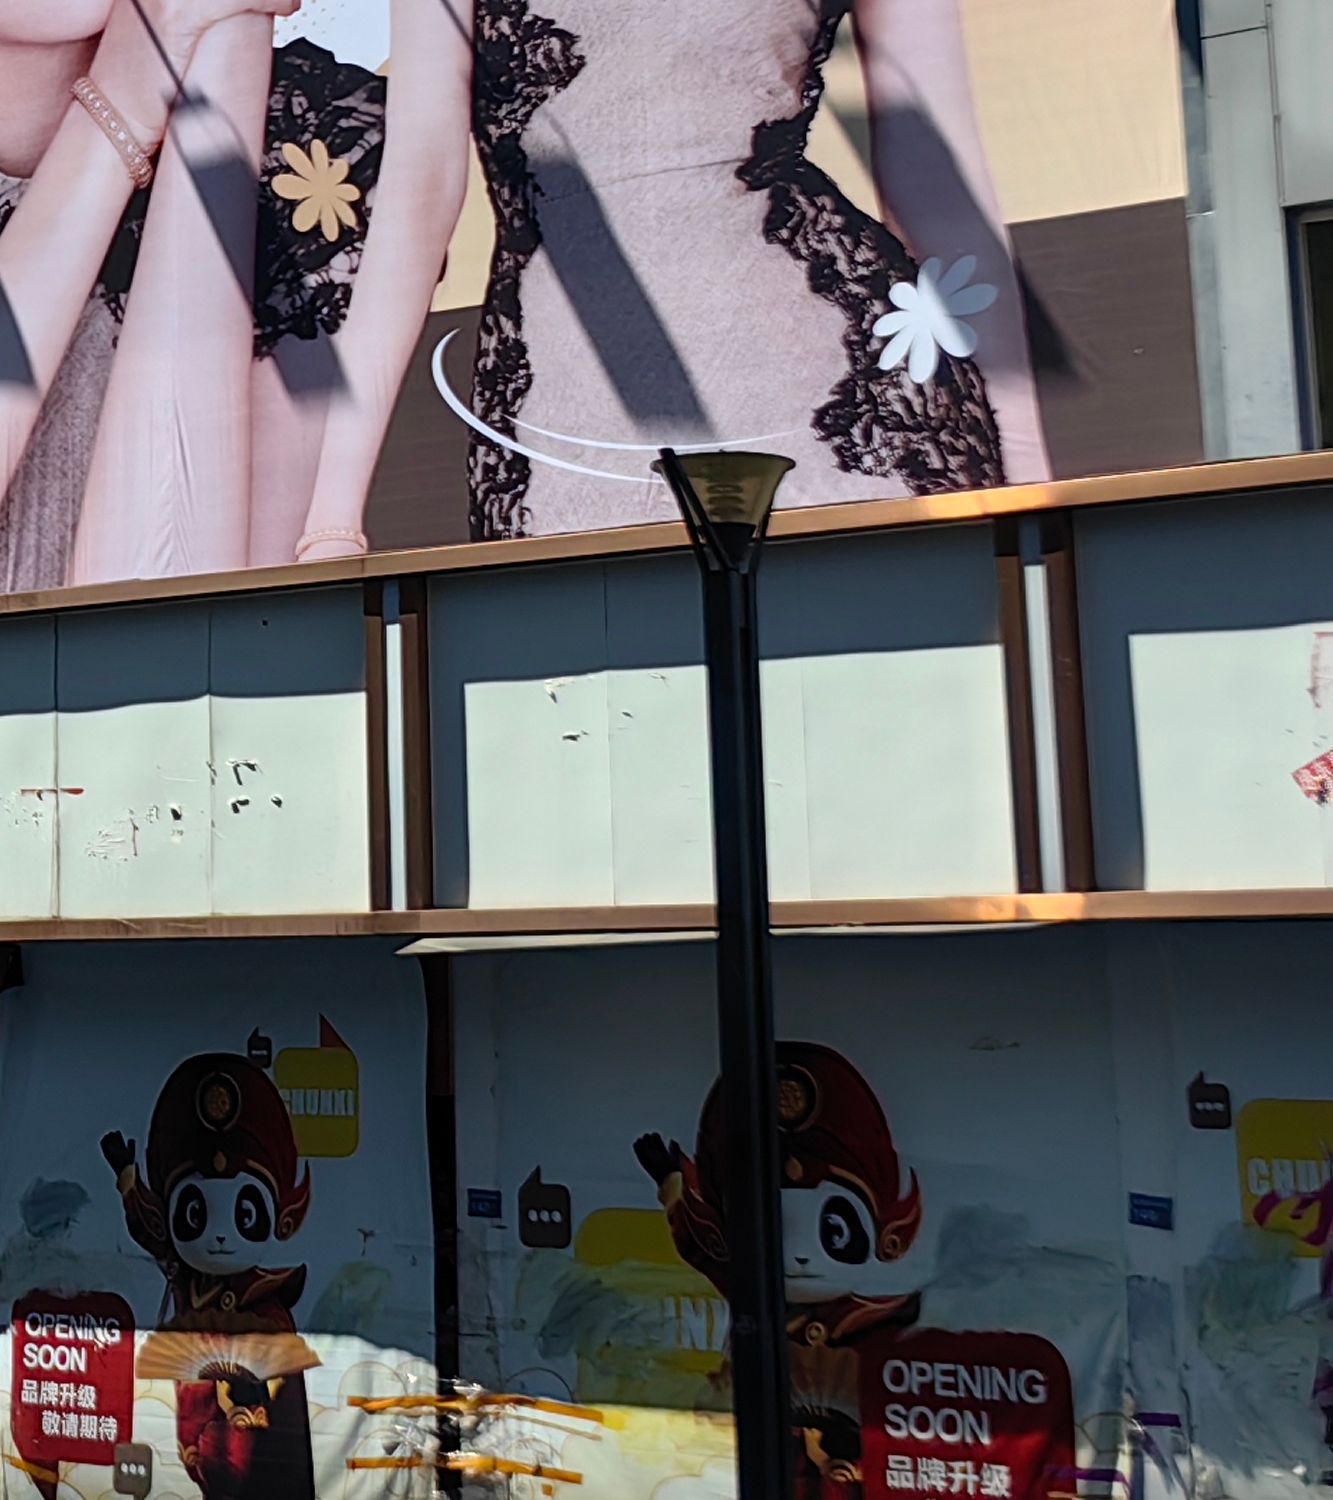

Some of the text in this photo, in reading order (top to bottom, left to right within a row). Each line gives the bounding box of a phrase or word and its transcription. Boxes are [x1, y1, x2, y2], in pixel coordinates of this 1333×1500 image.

[25, 1312, 121, 1343] OPENING
[23, 1342, 87, 1372] SOON
[21, 1379, 97, 1409] 品牌升级
[882, 1359, 1047, 1404] OPENING
[42, 1410, 117, 1442] 敬请期待
[884, 1403, 992, 1445] SOON
[886, 1454, 1011, 1499] 品牌升级
